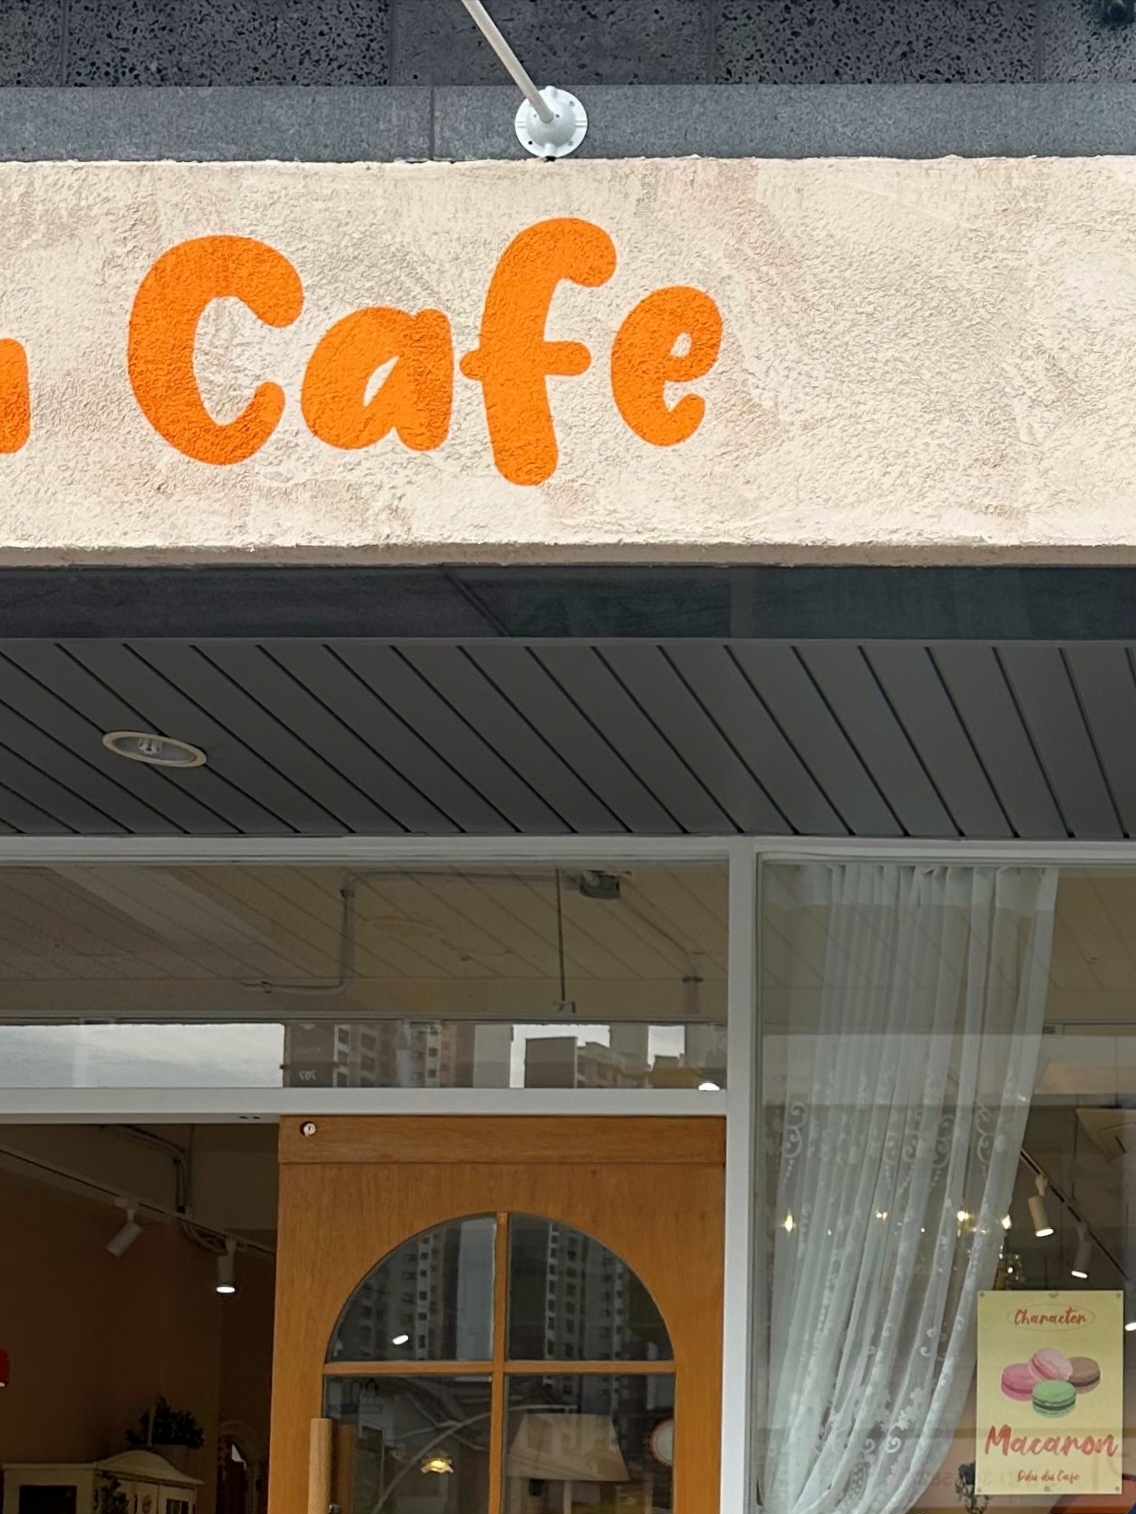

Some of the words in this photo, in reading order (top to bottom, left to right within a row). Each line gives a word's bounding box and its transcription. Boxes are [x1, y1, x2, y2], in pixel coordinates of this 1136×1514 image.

[127, 217, 724, 487] Cafe
[1014, 1306, 1088, 1326] Character
[984, 1424, 1119, 1457] Macaron
[1057, 1469, 1080, 1485] Cafe
